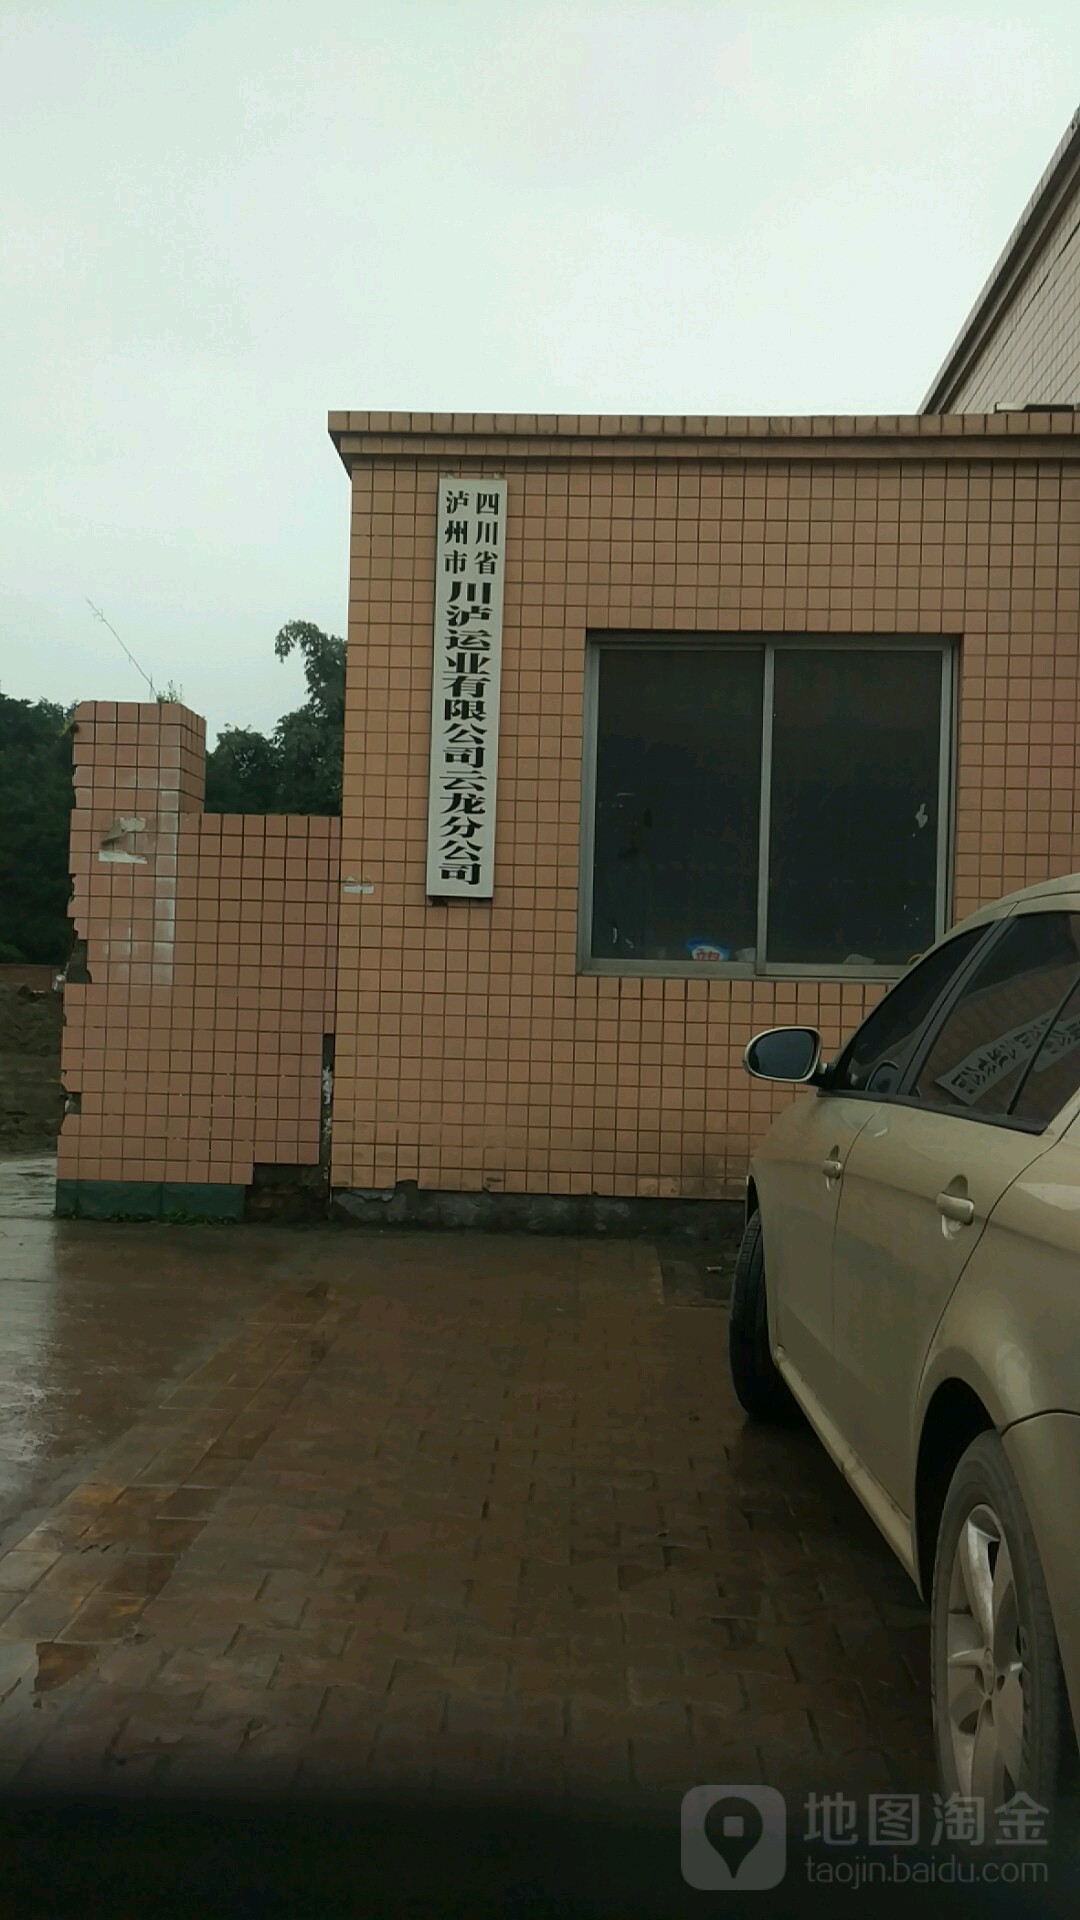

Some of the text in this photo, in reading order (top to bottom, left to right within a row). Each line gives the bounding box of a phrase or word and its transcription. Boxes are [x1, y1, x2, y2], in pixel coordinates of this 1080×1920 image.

[443, 490, 469, 574] 泸州市
[474, 492, 500, 575] 四川省
[438, 581, 493, 886] 川泸运业有限公司云龙分公司
